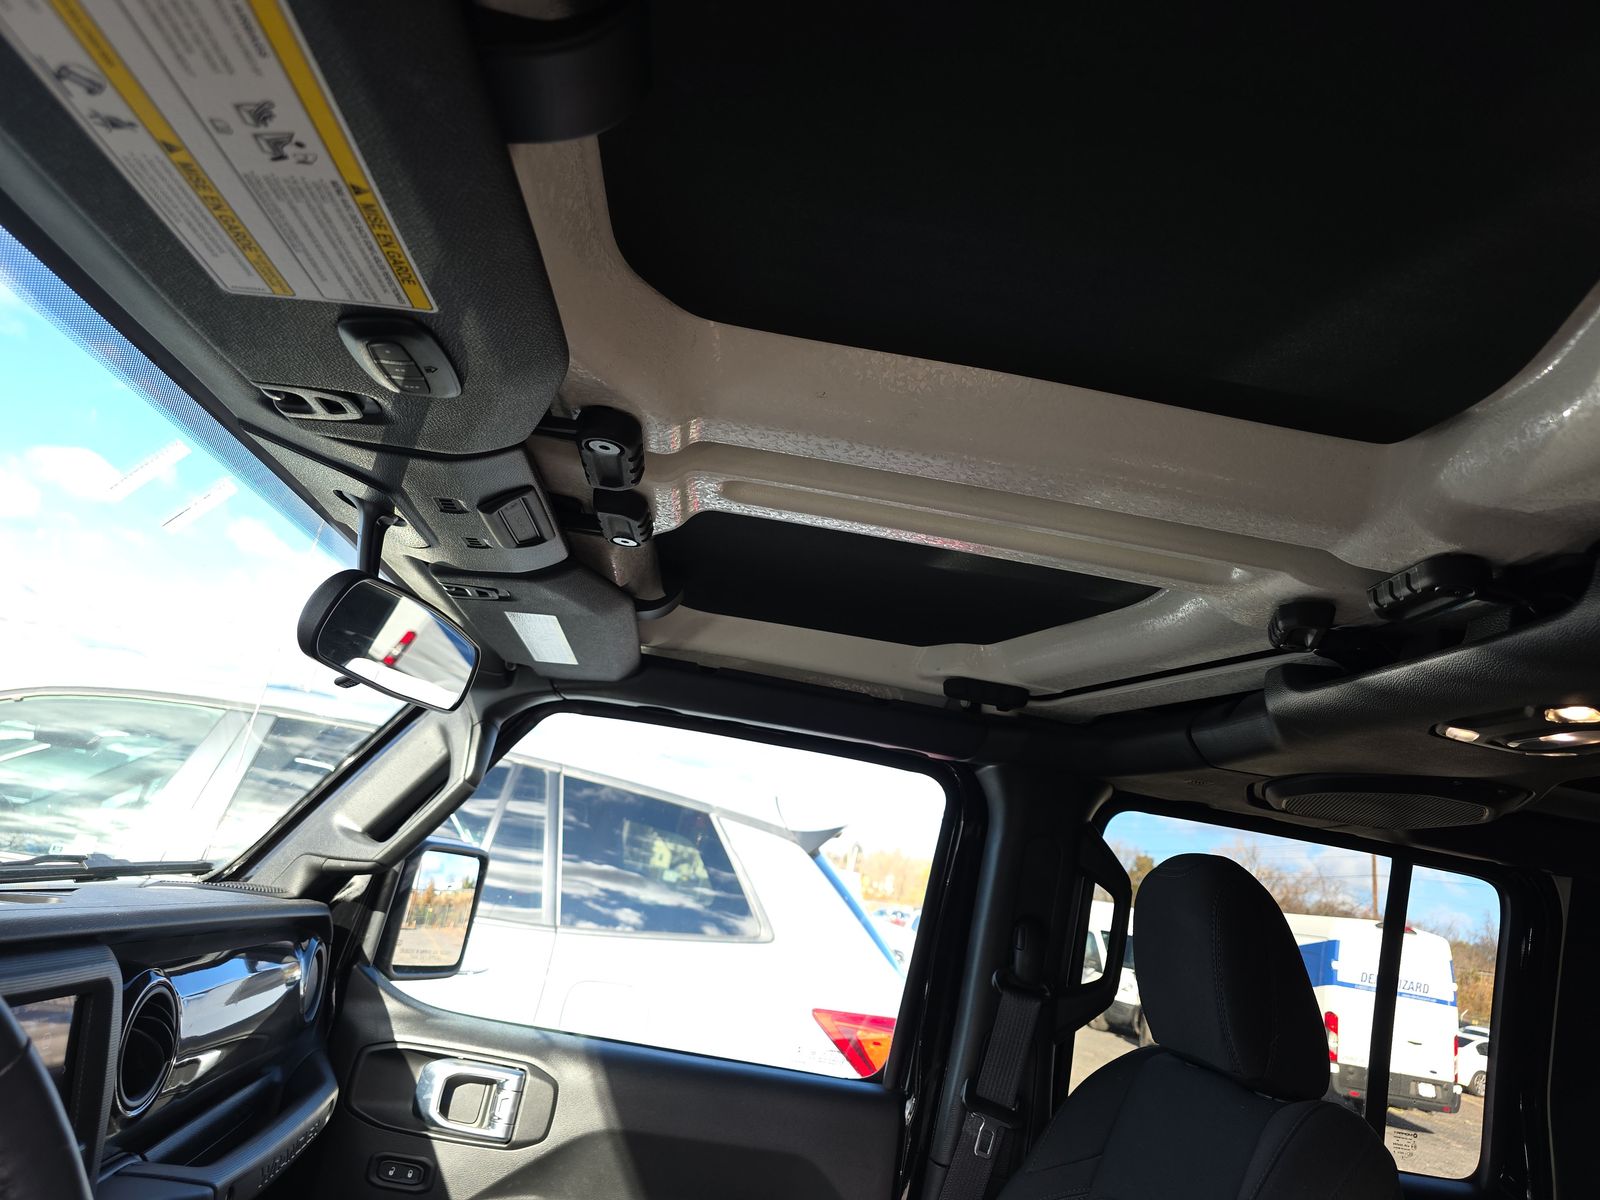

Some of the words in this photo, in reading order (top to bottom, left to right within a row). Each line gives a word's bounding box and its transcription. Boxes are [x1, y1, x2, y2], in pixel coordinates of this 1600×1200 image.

[178, 162, 213, 192] MISE
[202, 195, 226, 212] EN
[217, 214, 259, 252] GARDE
[362, 203, 388, 231] MISE
[376, 233, 398, 249] EN
[387, 250, 417, 286] GARDE
[1399, 979, 1430, 994] IZARD
